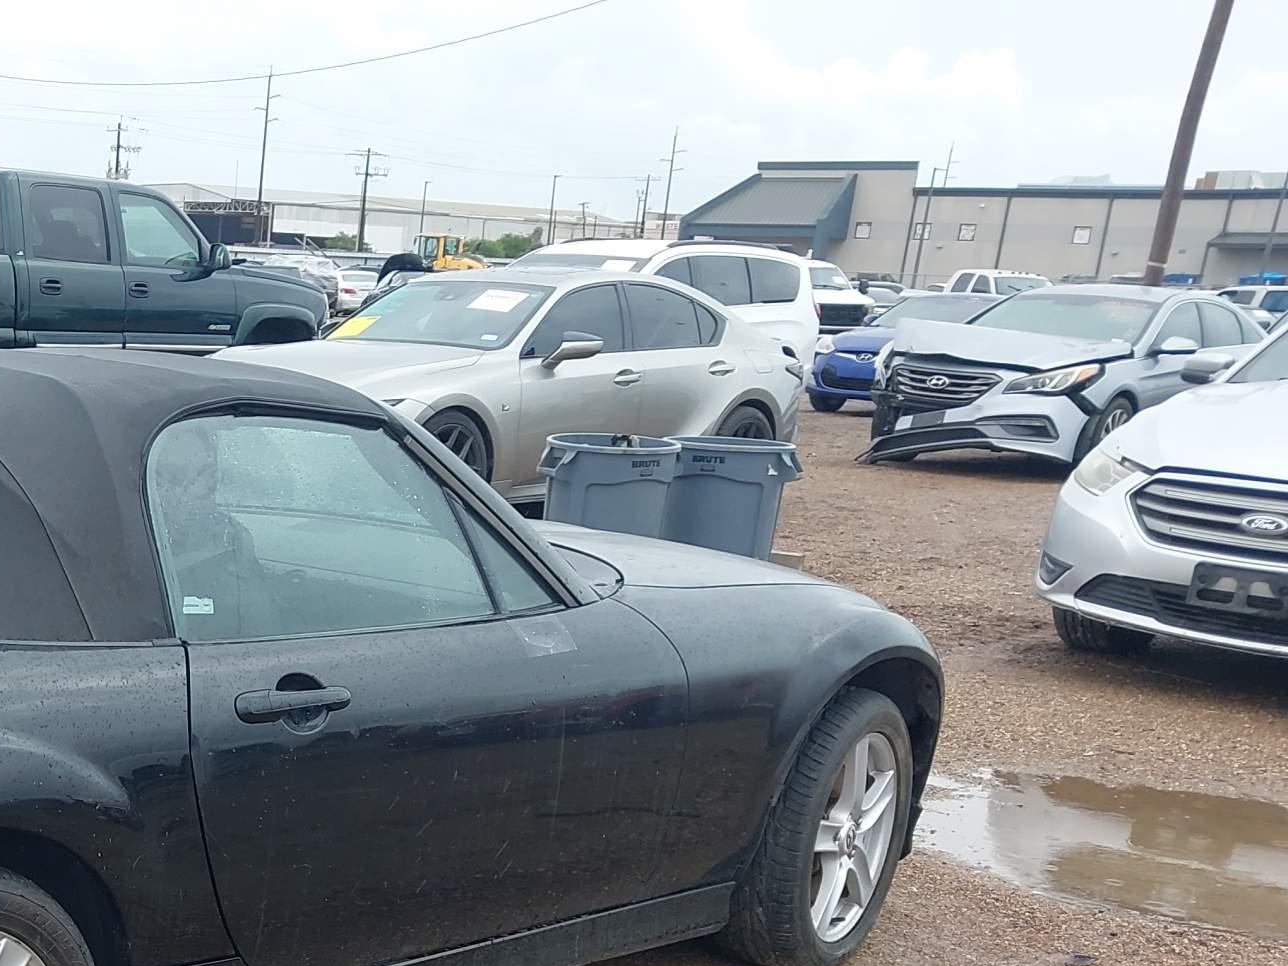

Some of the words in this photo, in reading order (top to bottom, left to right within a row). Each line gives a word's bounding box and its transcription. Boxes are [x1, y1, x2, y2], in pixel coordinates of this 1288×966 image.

[692, 455, 726, 464] BRUTE
[632, 460, 661, 469] BRUTE
[1250, 518, 1280, 530] Ford
